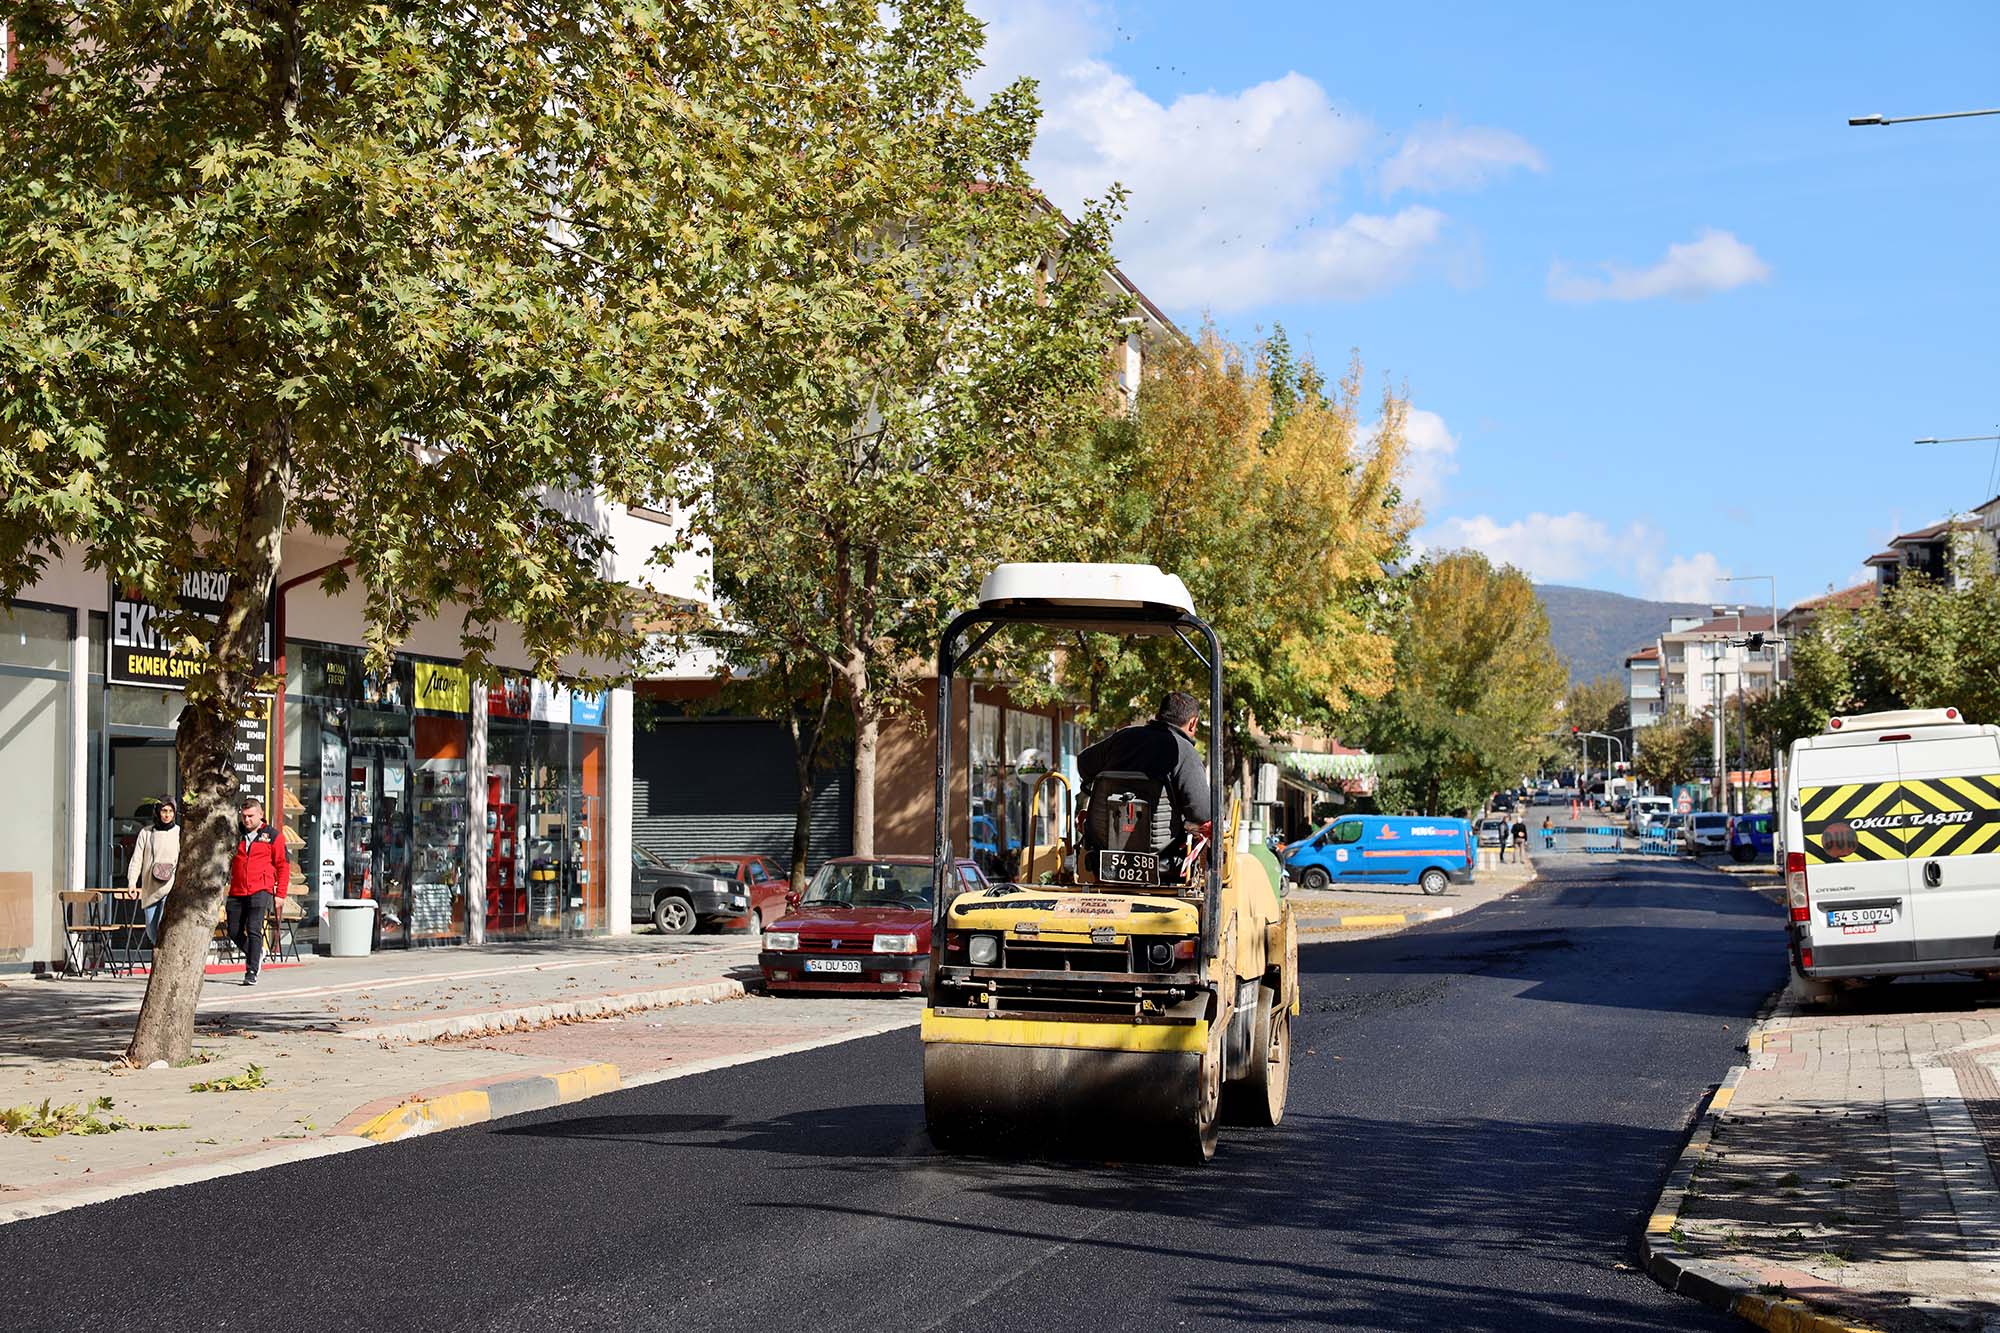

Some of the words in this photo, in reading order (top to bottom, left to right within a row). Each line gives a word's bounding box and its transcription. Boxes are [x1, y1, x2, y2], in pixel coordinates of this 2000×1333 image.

[176, 568, 230, 603] RABZO
[128, 655, 168, 677] EKMEK
[236, 719, 259, 729] RABZON
[1849, 815, 1903, 830] OKUL
[1909, 811, 1974, 827] TAŞITI
[1111, 854, 1127, 866] 54
[1133, 855, 1155, 869] SBB
[1119, 868, 1150, 882] 0821
[1834, 912, 1848, 922] 54
[1851, 911, 1859, 921] S
[1862, 909, 1890, 920] 0074
[1844, 925, 1875, 933] MOTUL
[811, 960, 822, 970] 54
[825, 961, 839, 971] DU
[842, 961, 859, 971] 503
